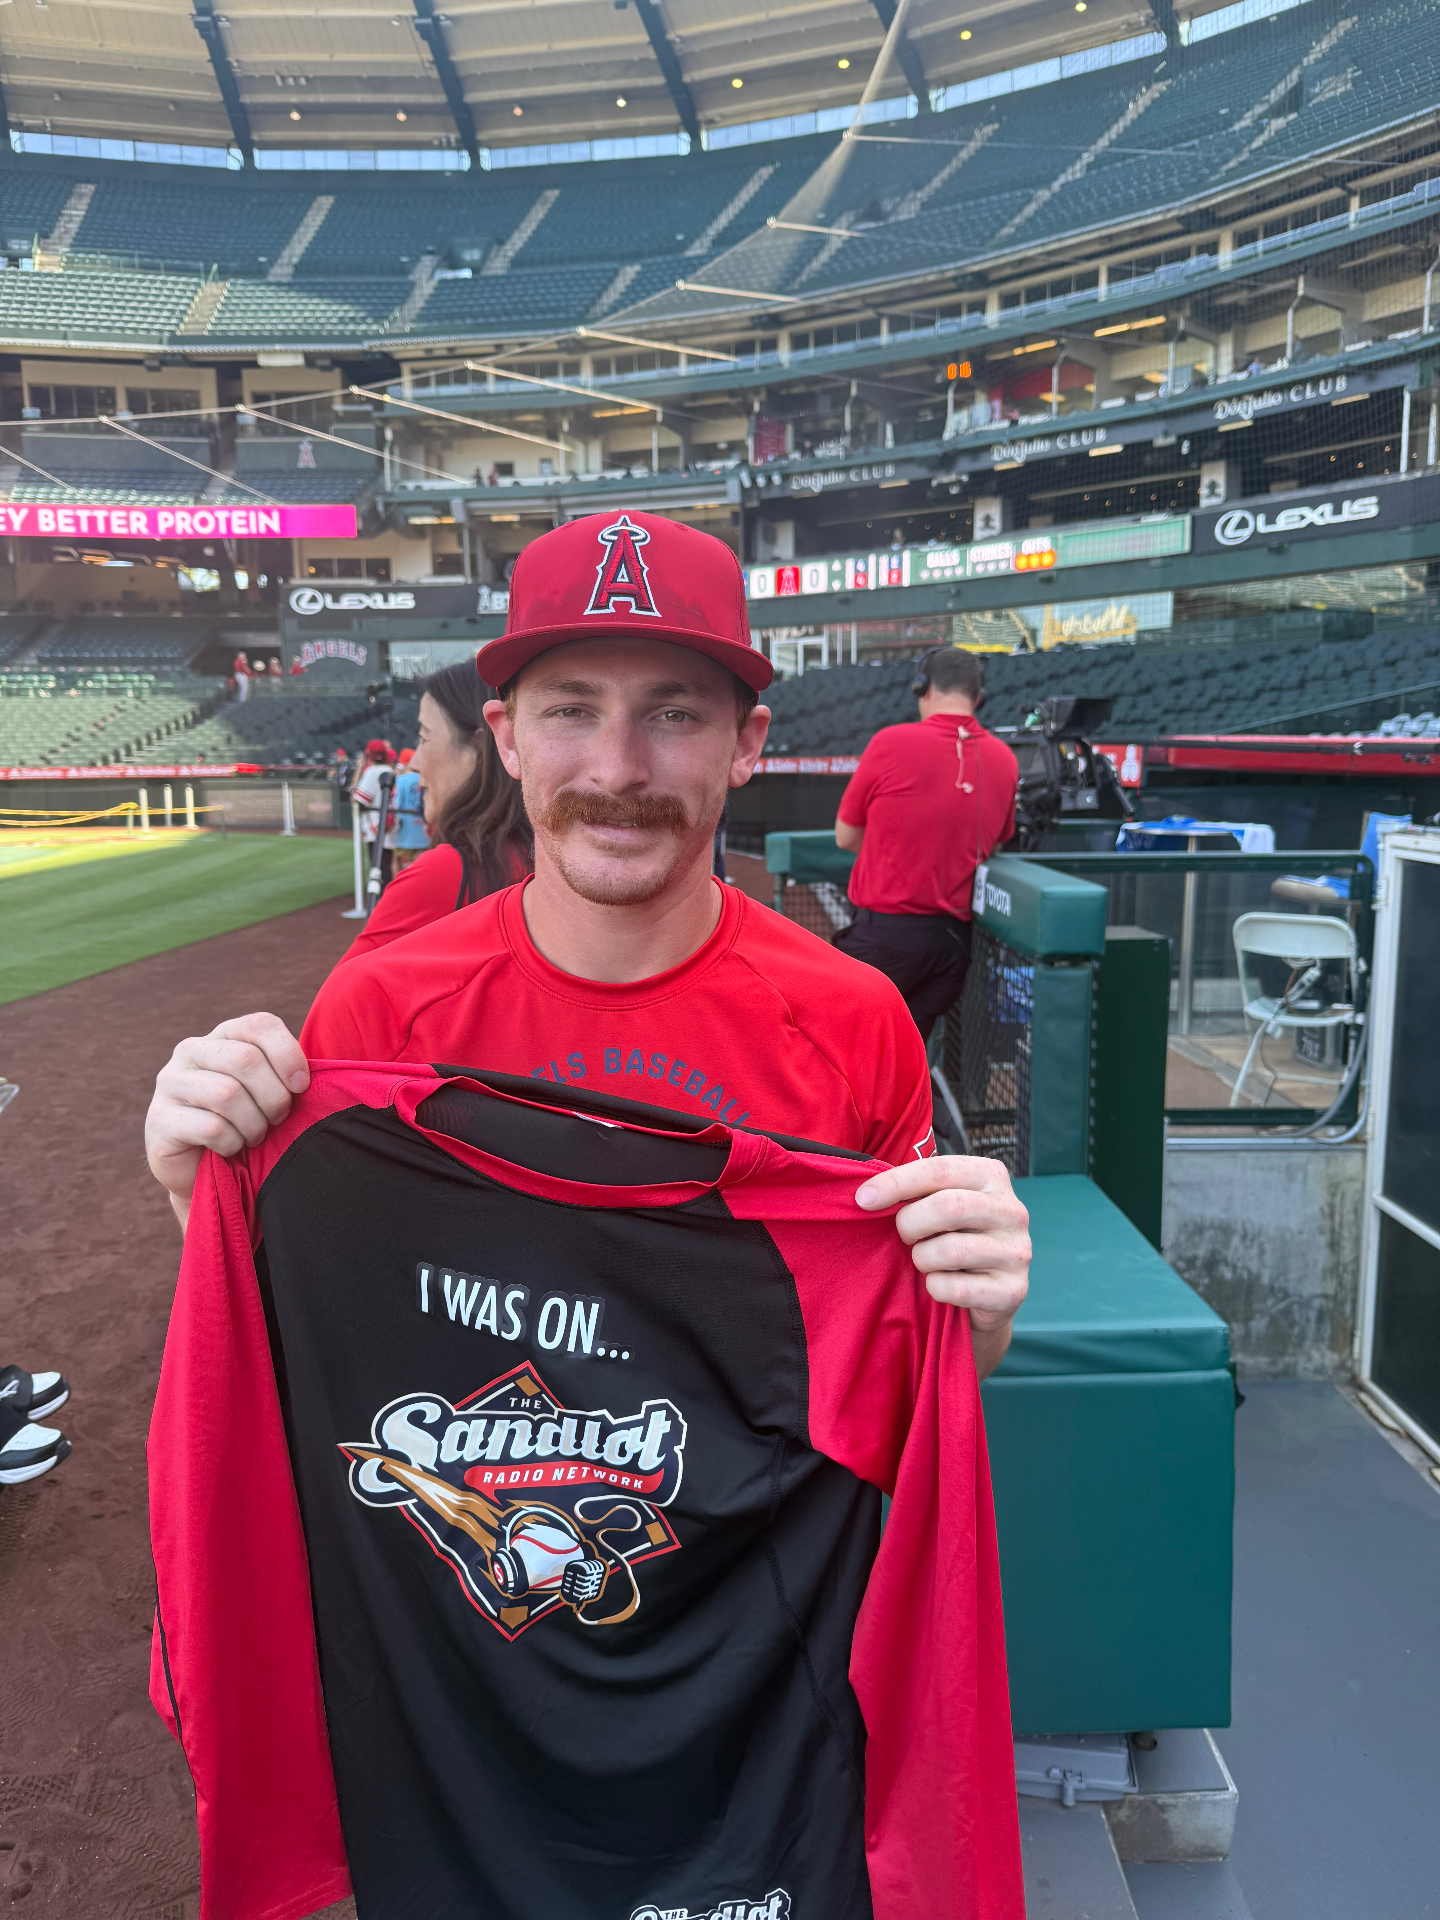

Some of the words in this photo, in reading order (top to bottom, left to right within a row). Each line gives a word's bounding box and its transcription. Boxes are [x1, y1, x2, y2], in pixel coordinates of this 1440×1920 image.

[1290, 375, 1348, 401] CLUB
[1056, 427, 1107, 450] CLUB
[850, 463, 896, 482] CLUB
[37, 508, 148, 535] BETTER
[157, 509, 281, 535] PROTEIN
[1256, 496, 1380, 534] LEXUS
[583, 515, 662, 617] A
[323, 592, 416, 609] LEXUS
[300, 638, 368, 666] ANGELS
[986, 882, 1012, 917] TOYOTA
[420, 1268, 430, 1313] I
[443, 1274, 525, 1341] WAS
[537, 1297, 630, 1360] ON...
[509, 1397, 543, 1409] THE
[358, 1401, 672, 1494] Sandlot
[483, 1467, 543, 1485] RADIO
[552, 1466, 645, 1490] NETWORK
[664, 1910, 685, 1920] THE
